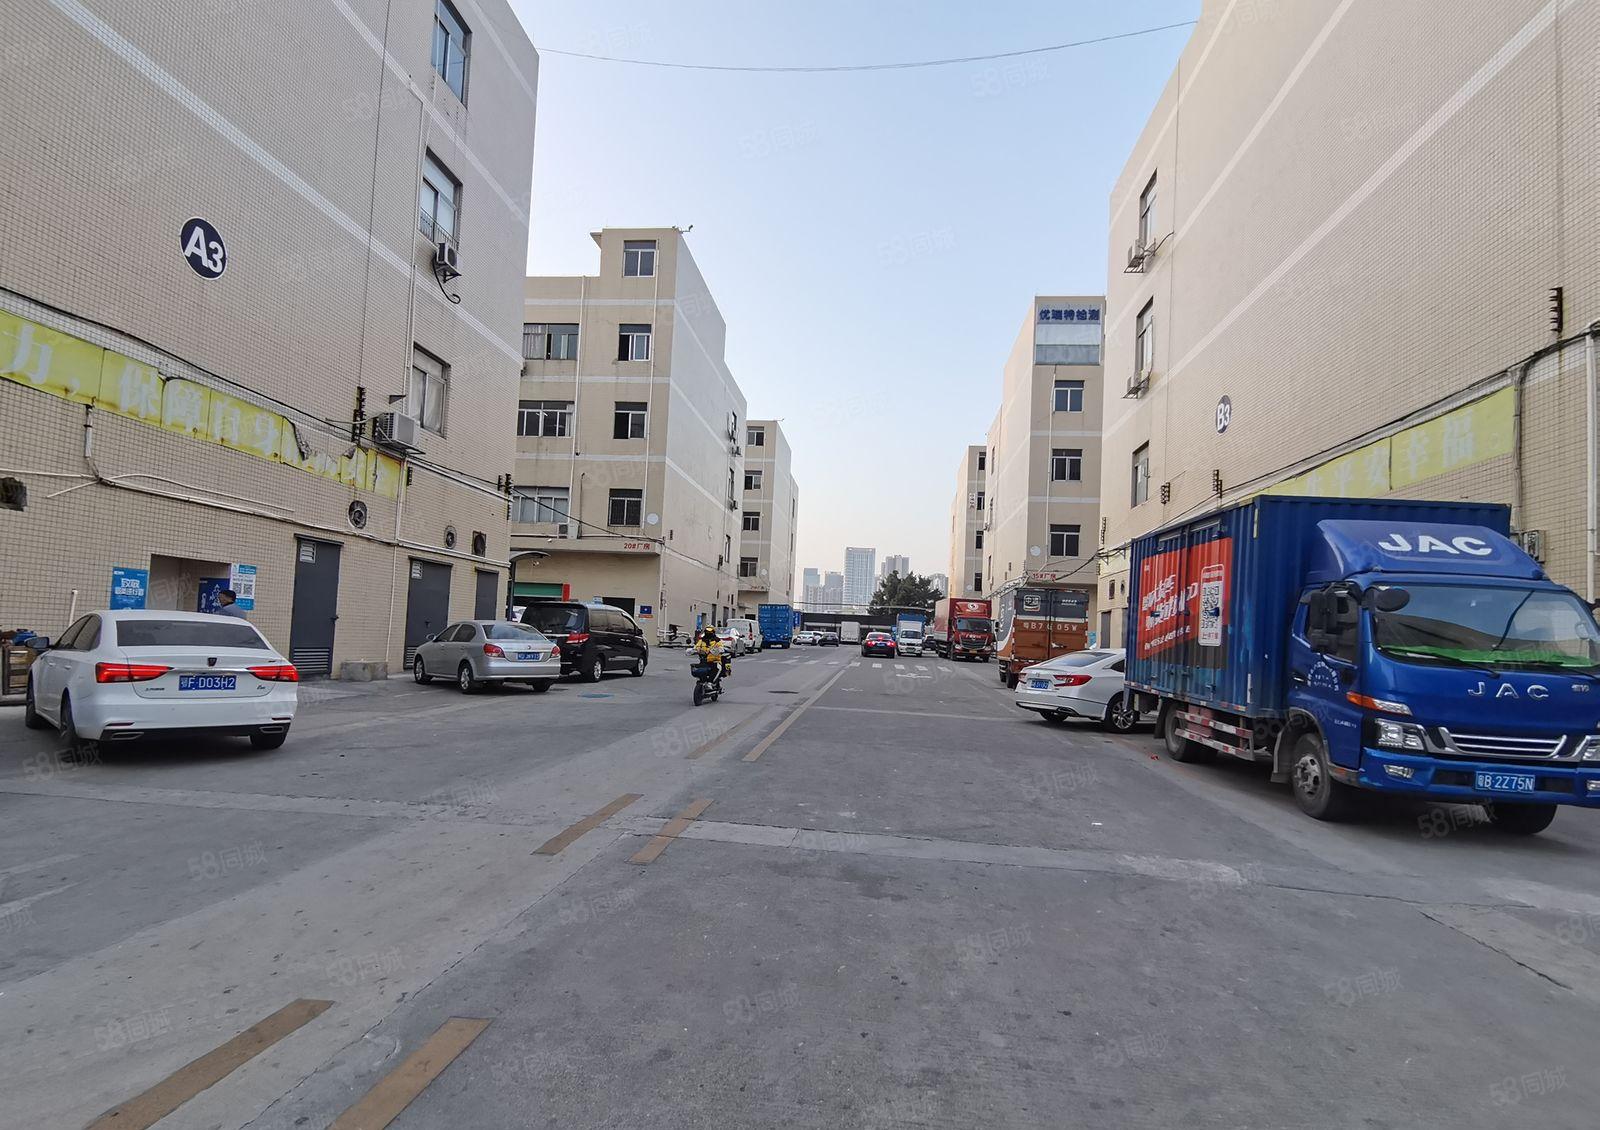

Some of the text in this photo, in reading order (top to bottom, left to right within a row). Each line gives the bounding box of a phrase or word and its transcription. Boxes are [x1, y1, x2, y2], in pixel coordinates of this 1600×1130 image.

[184, 225, 225, 273] A3
[1039, 308, 1101, 321] 优瑞特检测
[1216, 400, 1232, 431] B3
[1378, 533, 1493, 556] JAC
[1467, 681, 1549, 701] JAC
